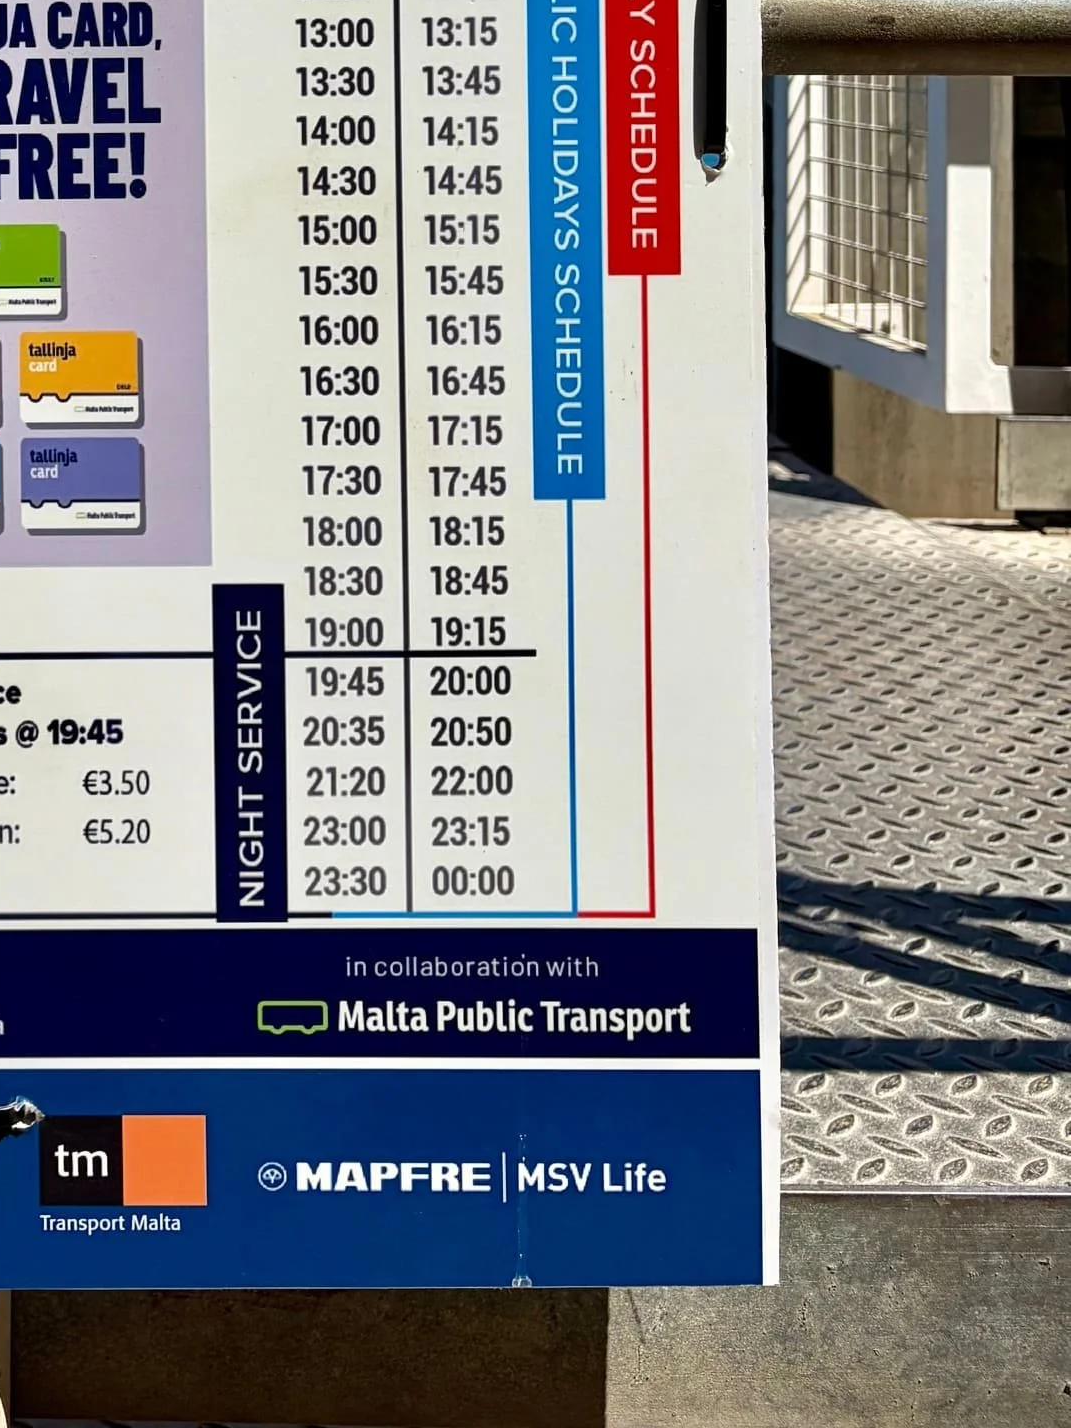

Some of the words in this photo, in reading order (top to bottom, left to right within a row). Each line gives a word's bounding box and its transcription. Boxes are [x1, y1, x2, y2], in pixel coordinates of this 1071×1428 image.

[47, 1, 162, 51] CARD,
[551, 56, 580, 251] HOLIDAYS
[629, 39, 658, 248] SCHEDULE
[29, 342, 77, 360] tallinja
[29, 358, 57, 372] card
[554, 263, 583, 474] SCHEDULE
[30, 448, 78, 467] tallinja
[30, 464, 58, 479] card
[304, 617, 384, 647] 19:00
[430, 616, 506, 647] 19:15
[235, 610, 263, 774] SERVICE
[305, 666, 385, 697] 19:45
[430, 665, 511, 696] 20:00
[15, 719, 40, 749] @
[46, 718, 124, 745] 19:45
[82, 769, 150, 796] €3.50
[306, 766, 386, 797] 21:20
[431, 765, 513, 796] 22:00
[82, 818, 151, 845] €5.20
[238, 785, 265, 907] NIGHT
[304, 866, 387, 897] 23:30
[432, 865, 515, 896] 00:00
[346, 956, 367, 977] in
[374, 953, 539, 977] collaboration
[546, 956, 599, 977] with
[338, 1000, 430, 1032] Malta
[436, 998, 534, 1033] Public
[539, 1000, 692, 1041] Transport
[54, 1144, 109, 1177] tm
[296, 1162, 491, 1192] MAPFRE
[518, 1162, 592, 1192] MSV
[603, 1162, 667, 1192] Life
[39, 1214, 126, 1236] Transport
[131, 1212, 181, 1231] Malta
